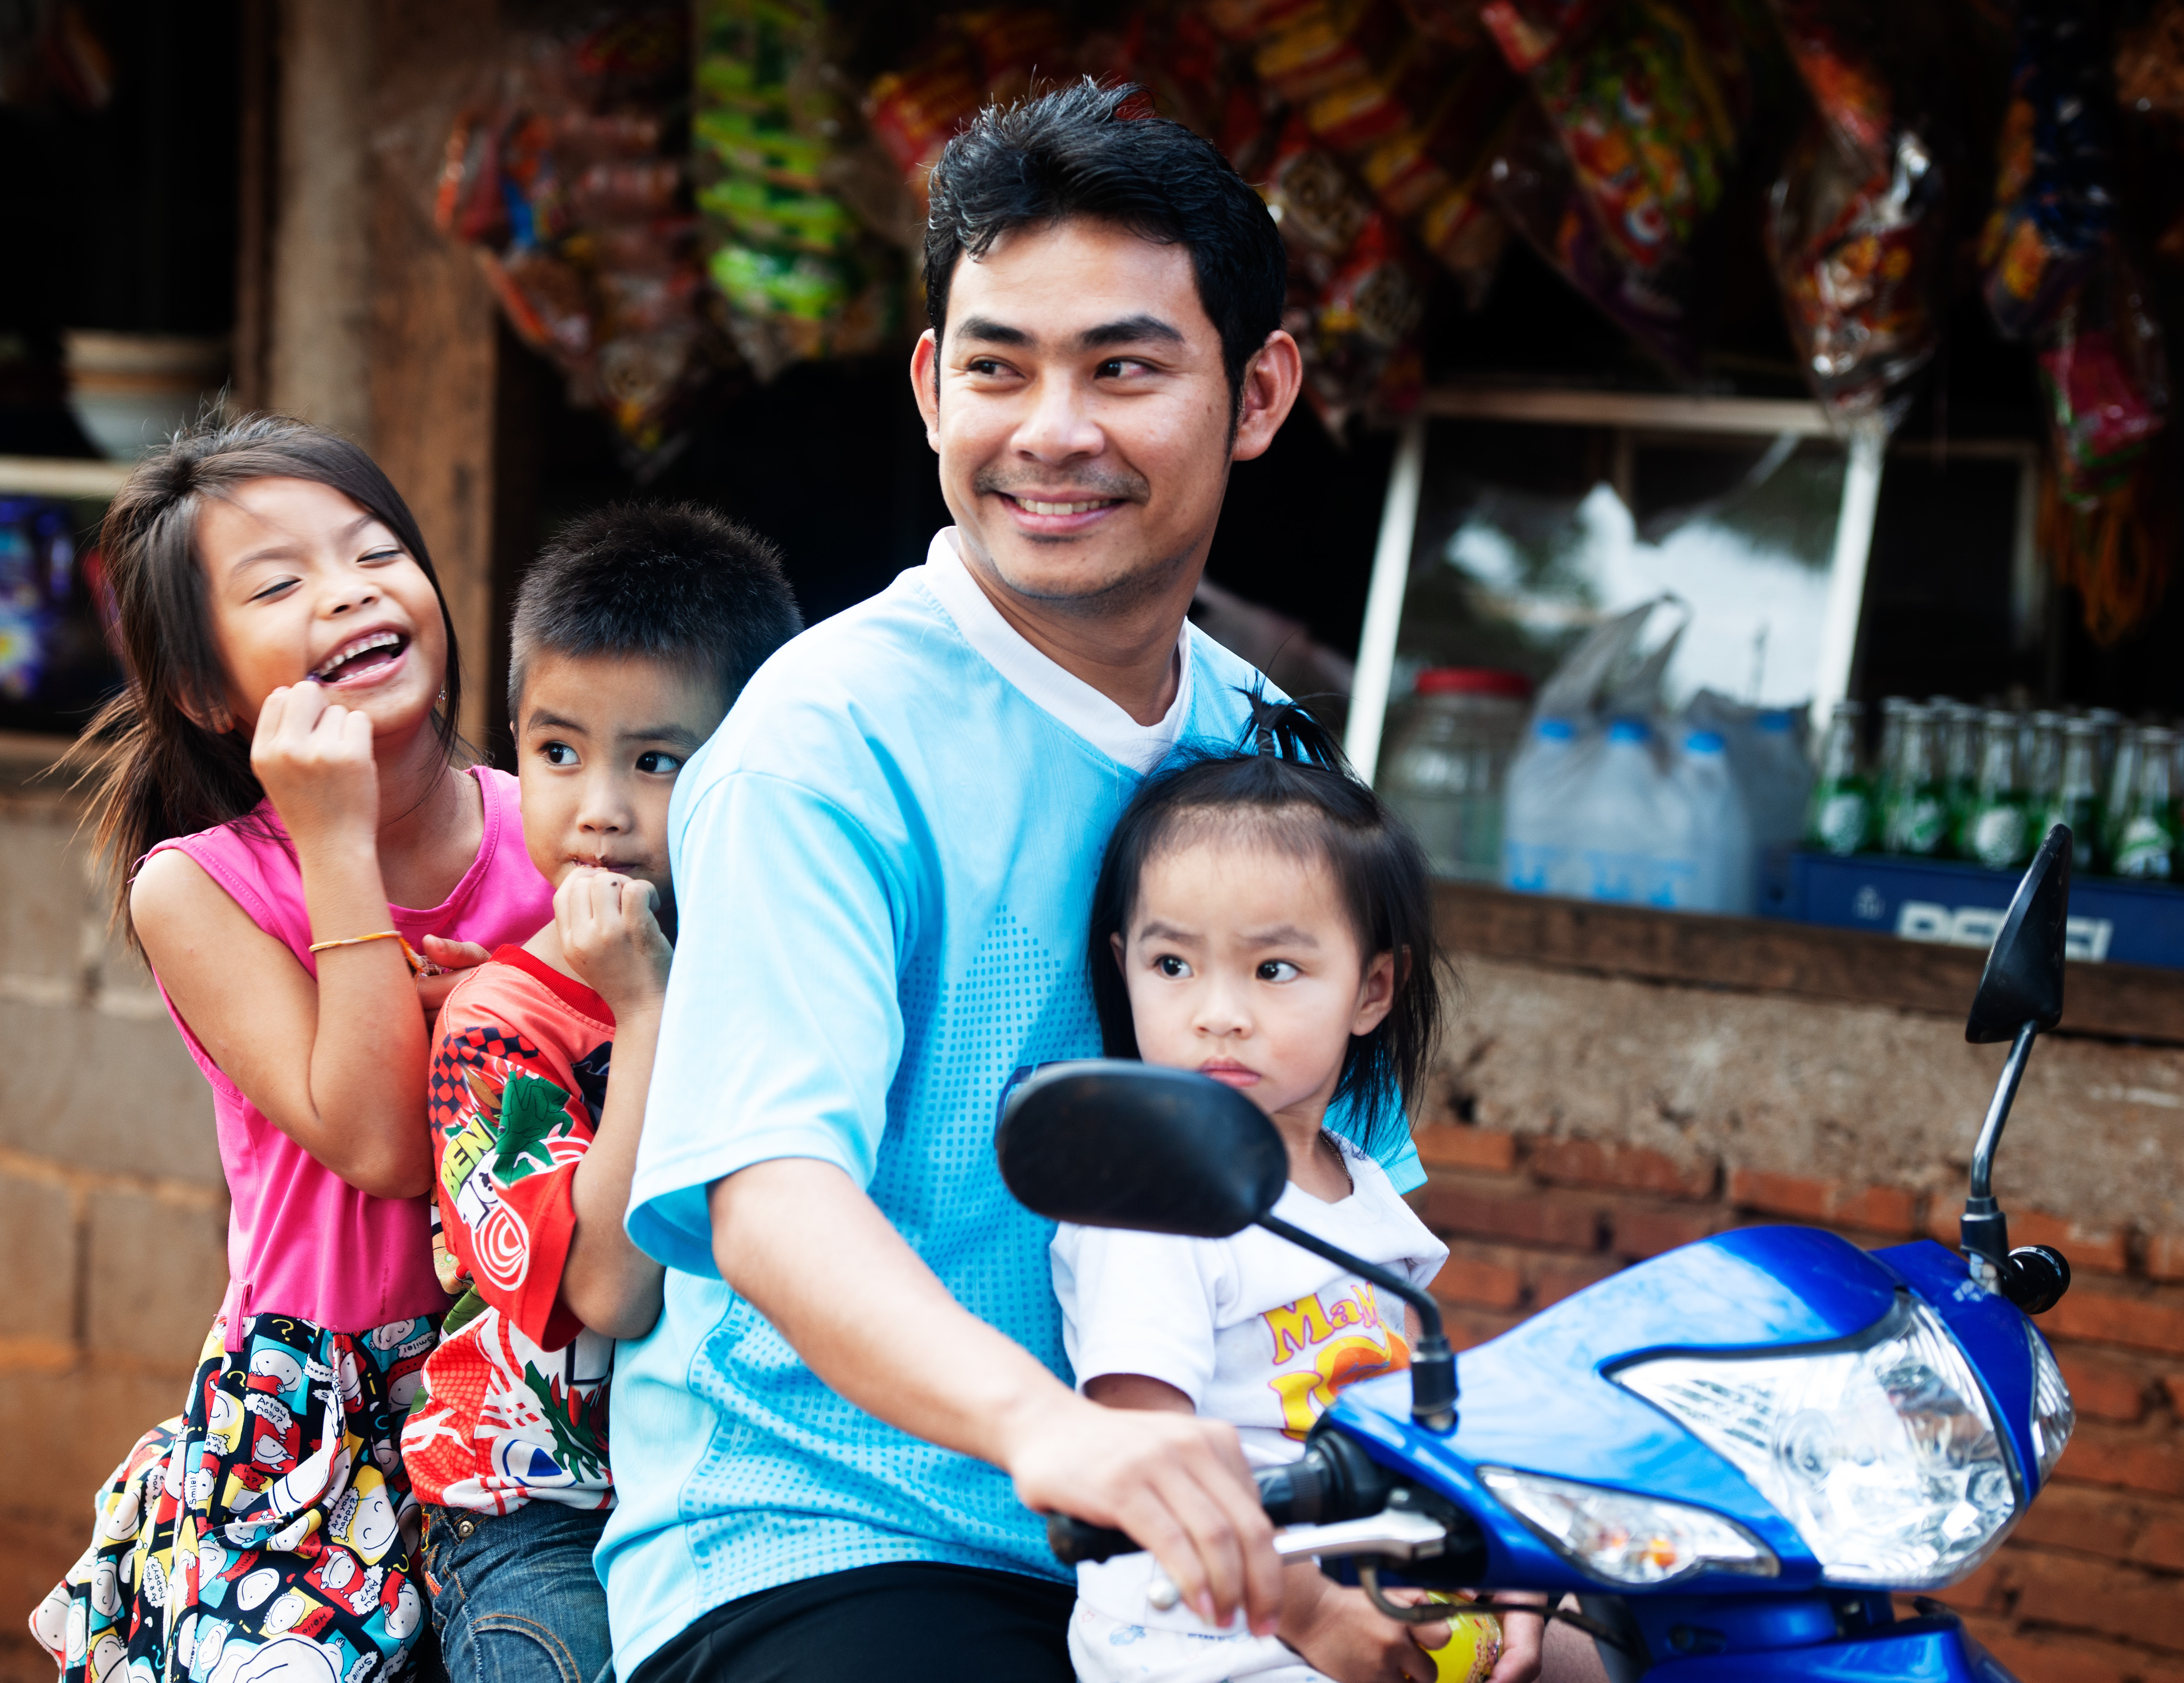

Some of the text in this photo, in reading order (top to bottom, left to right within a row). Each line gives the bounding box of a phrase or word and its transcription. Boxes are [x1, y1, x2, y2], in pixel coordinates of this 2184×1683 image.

[441, 1117, 496, 1202] BEN
[331, 1494, 352, 1529] Are you
[337, 1497, 357, 1533] happy?
[151, 1563, 166, 1600] happy?
